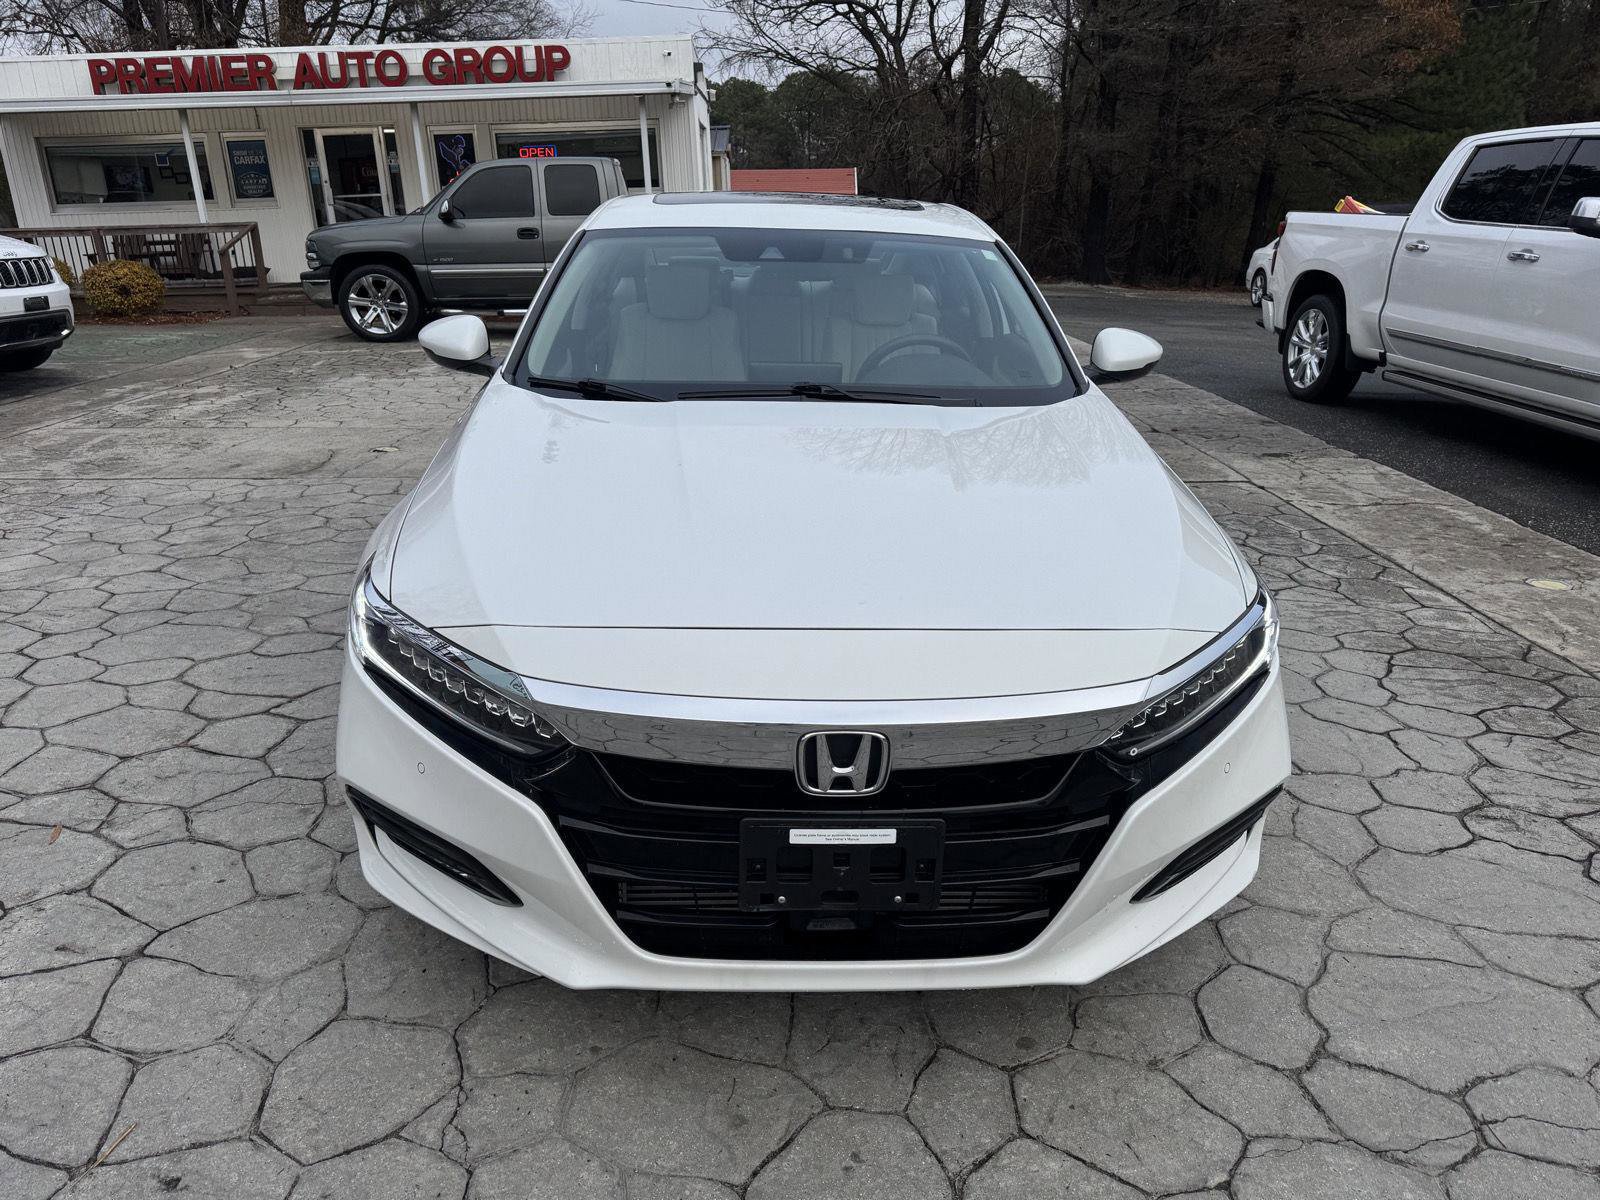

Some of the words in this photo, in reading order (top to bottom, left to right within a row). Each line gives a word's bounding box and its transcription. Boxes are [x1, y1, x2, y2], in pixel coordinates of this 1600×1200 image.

[87, 53, 278, 96] PREMIER
[293, 49, 408, 90] AUTO
[422, 45, 572, 86] GROUP
[519, 147, 554, 158] OPEN
[233, 155, 266, 165] CARFAX
